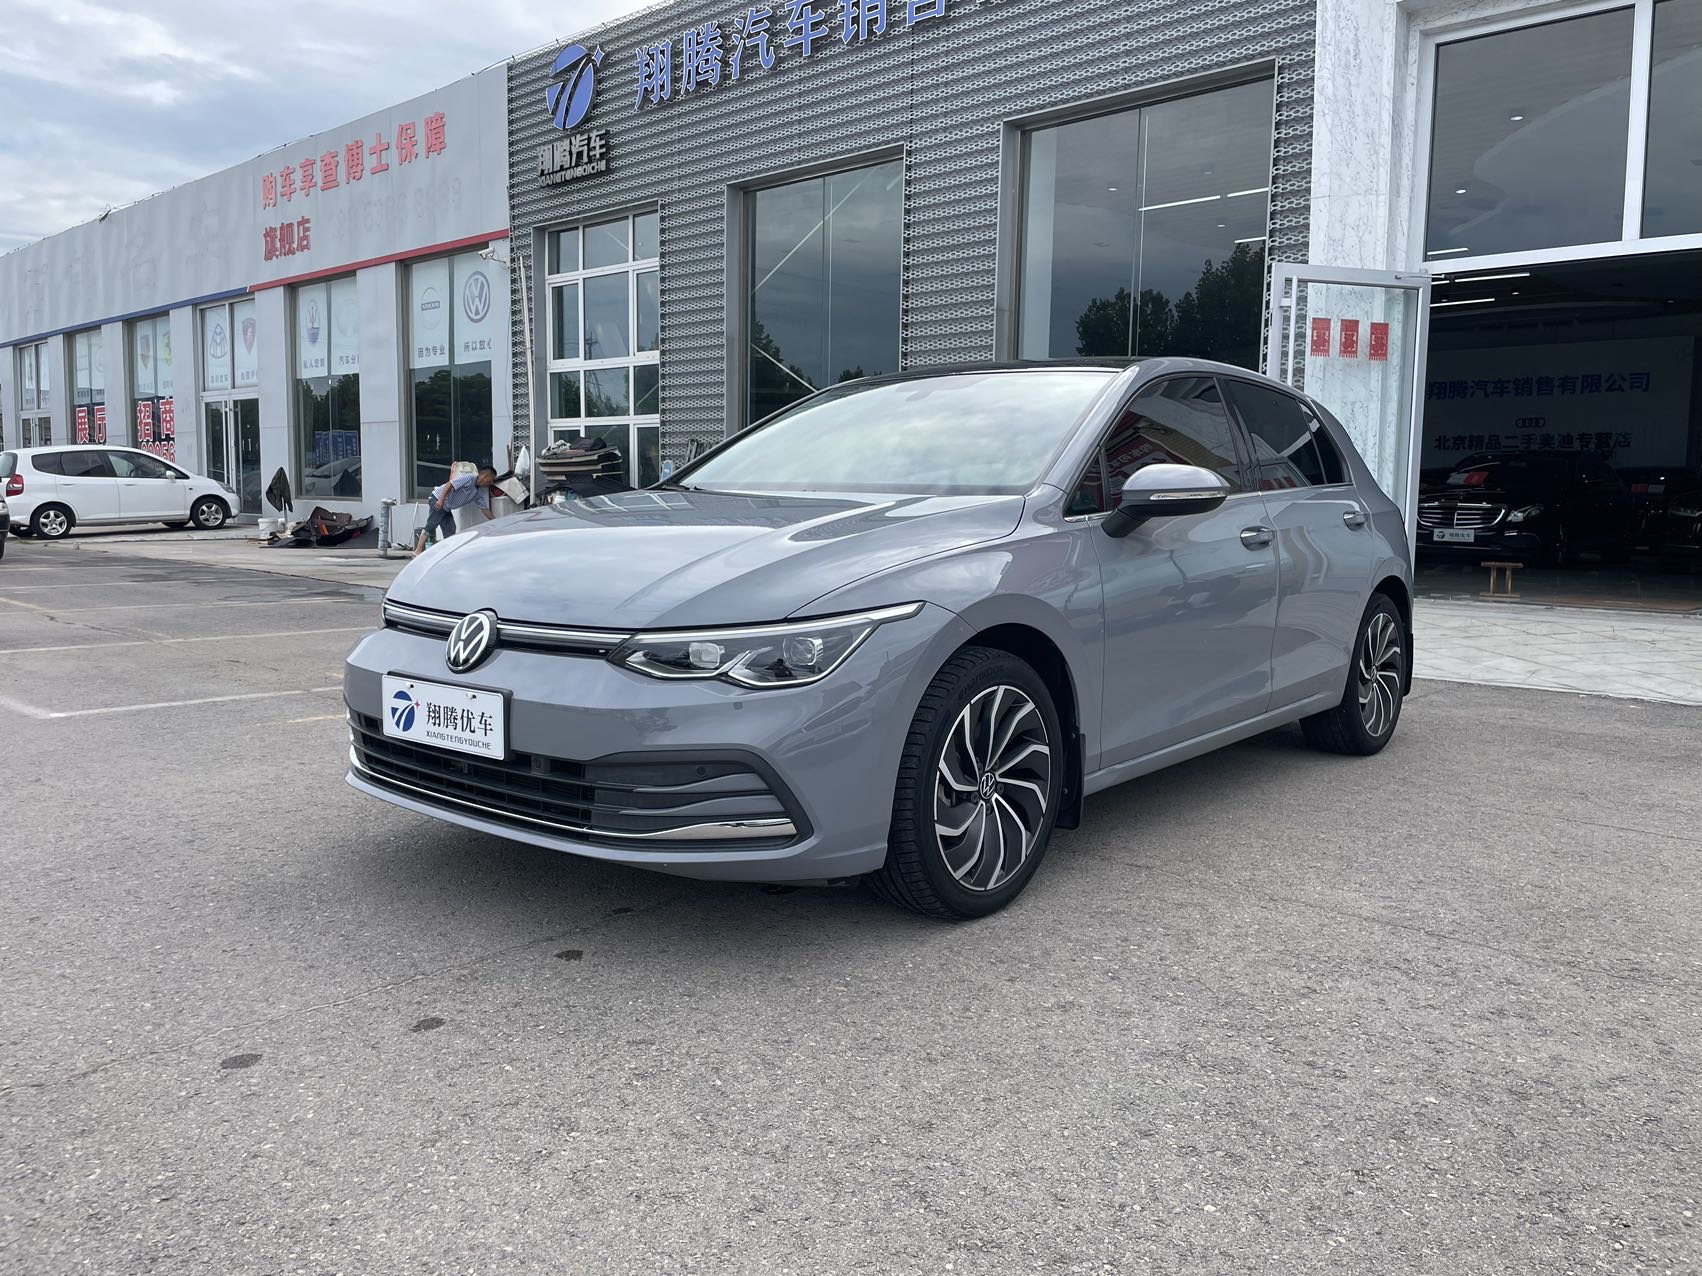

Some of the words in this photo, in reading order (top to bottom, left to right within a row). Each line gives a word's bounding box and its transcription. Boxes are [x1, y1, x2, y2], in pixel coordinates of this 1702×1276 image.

[261, 111, 448, 210] 购车享查博士保障
[538, 129, 607, 176] 翔腾汽车
[262, 215, 312, 262] 旗舰店
[1427, 371, 1651, 401] 翔腾汽车销售有限公司
[76, 405, 106, 444] 展厅
[137, 396, 176, 442] 招商
[425, 730, 492, 751] XIANGTENGYOUCHE
[426, 702, 494, 737] 翔腾优车
